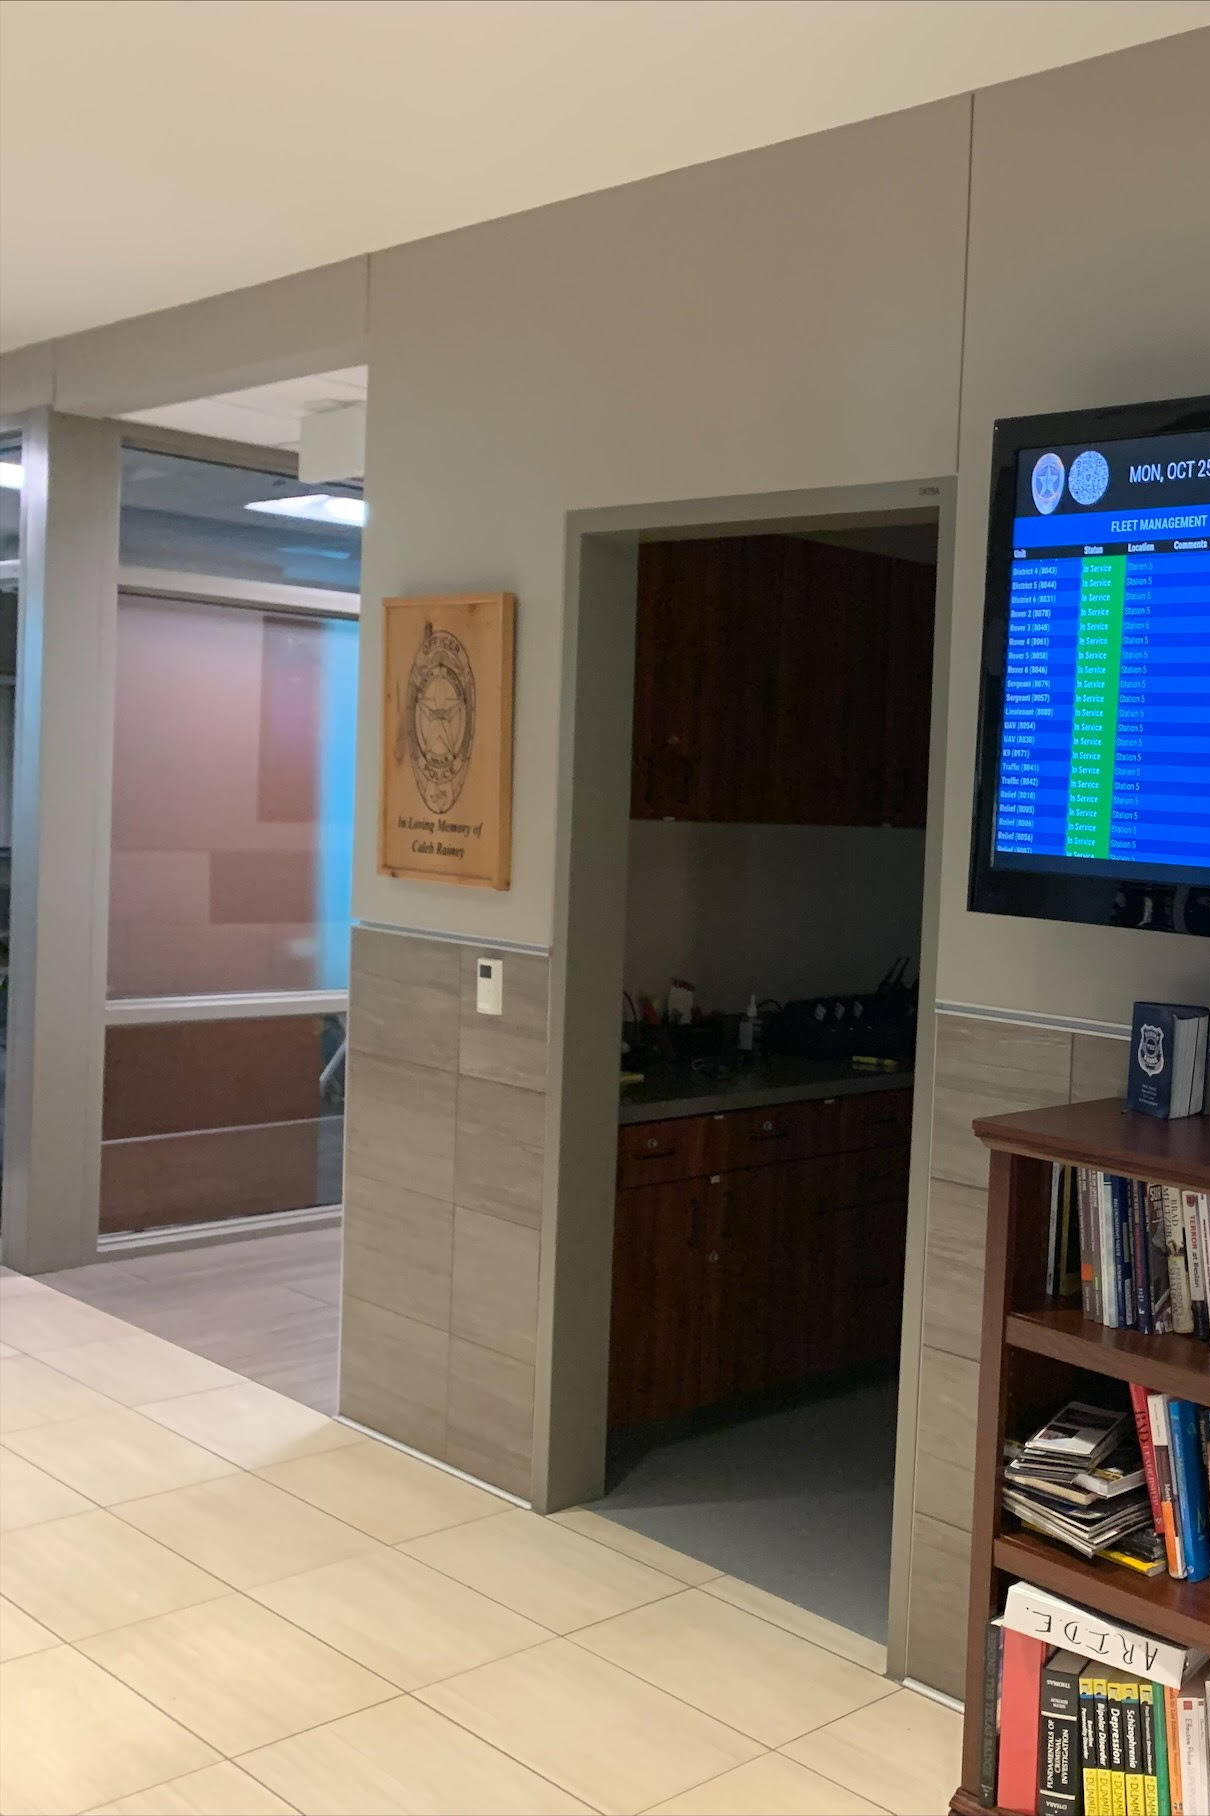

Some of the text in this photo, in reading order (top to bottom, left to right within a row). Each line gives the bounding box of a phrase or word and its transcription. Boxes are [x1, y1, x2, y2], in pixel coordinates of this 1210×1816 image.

[1130, 463, 1163, 484] MON,
[1167, 460, 1196, 480] OCT
[1111, 515, 1208, 533] FLEET MANAGEMENT
[1084, 546, 1103, 555] Status
[1128, 542, 1155, 553] Location
[1173, 539, 1208, 551] Comments
[1090, 579, 1112, 587] Service
[1083, 694, 1104, 703] Service
[1078, 780, 1099, 789] Service
[1189, 1215, 1199, 1250] TERROR
[1046, 1679, 1071, 1690] THOMAS
[1097, 1702, 1108, 1766] Bipolar Disorder
[1110, 1708, 1122, 1765] Depression
[1127, 1710, 1138, 1769] Schizophrenia
[1046, 1719, 1056, 1789] FUNDAMENTALS OF
[1054, 1738, 1062, 1774] CRIMINAL
[1061, 1729, 1069, 1785] INVESTIGATION
